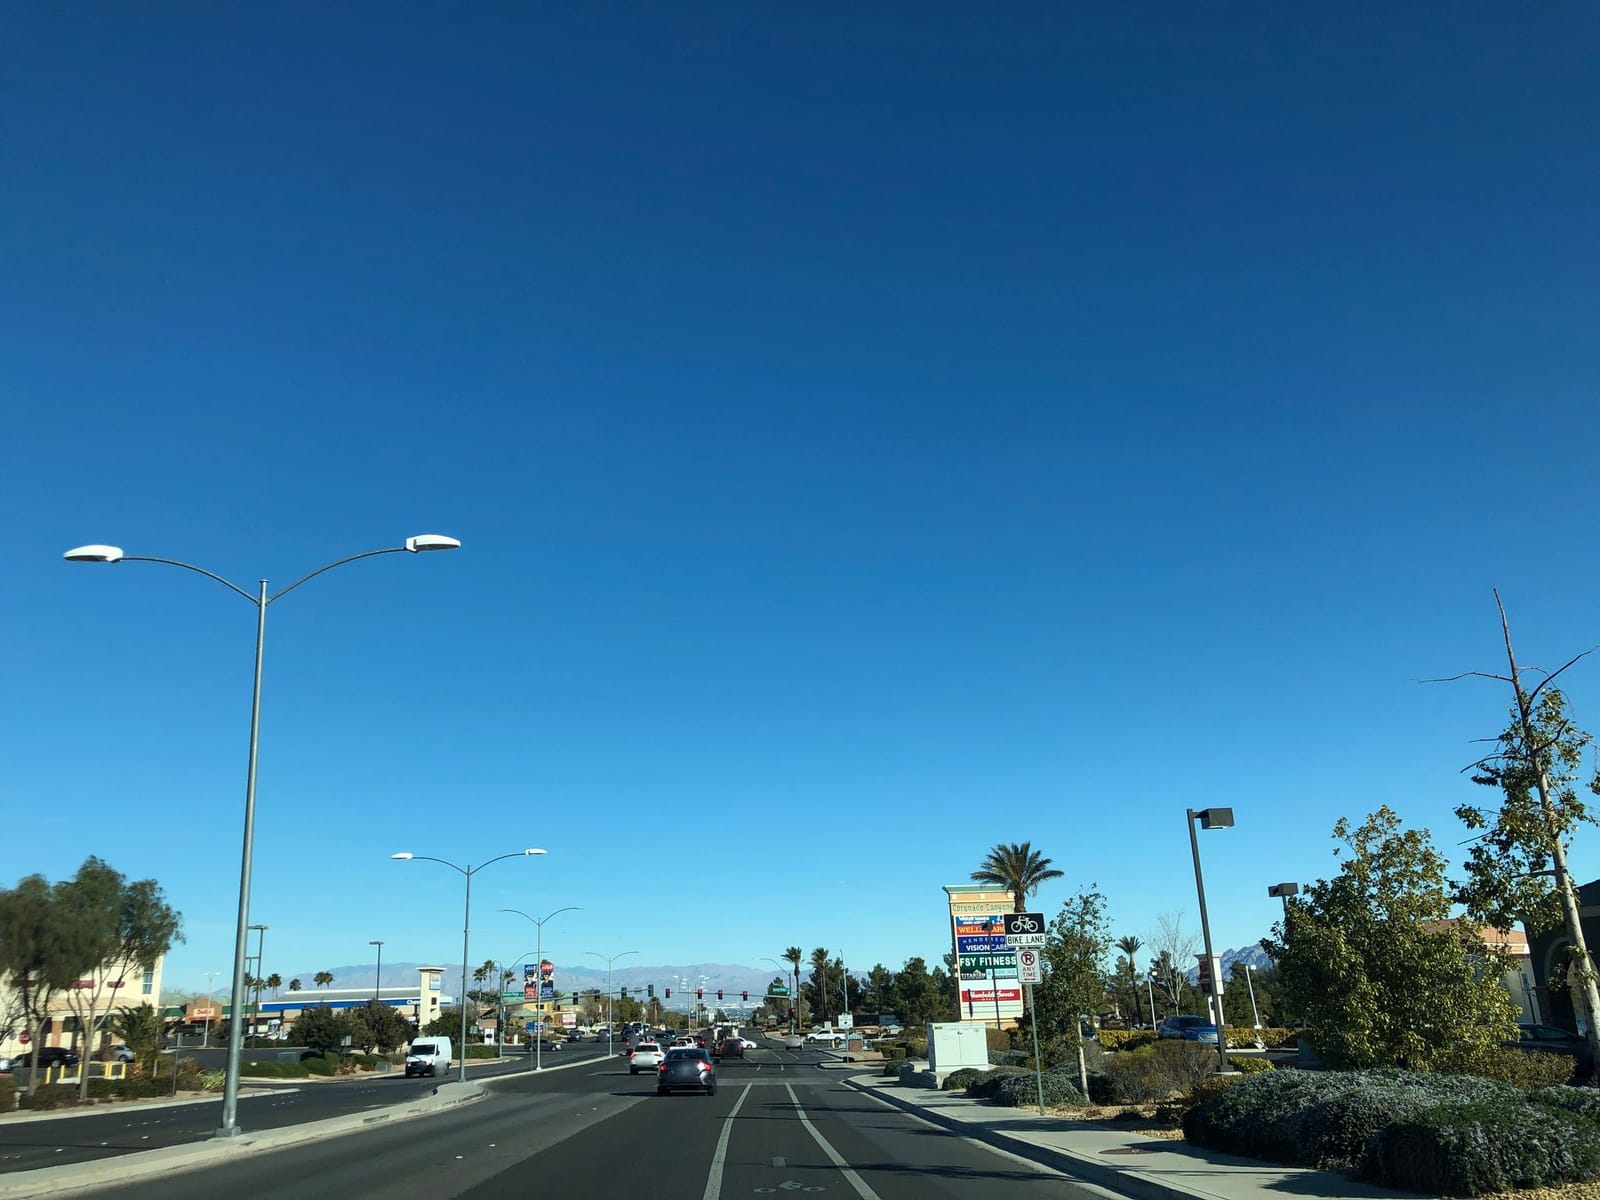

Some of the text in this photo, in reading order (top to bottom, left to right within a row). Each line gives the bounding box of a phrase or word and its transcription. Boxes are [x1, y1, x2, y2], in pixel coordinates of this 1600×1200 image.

[1008, 935, 1045, 944] BIKE LANE
[960, 956, 1017, 967] FSY FITNESS
